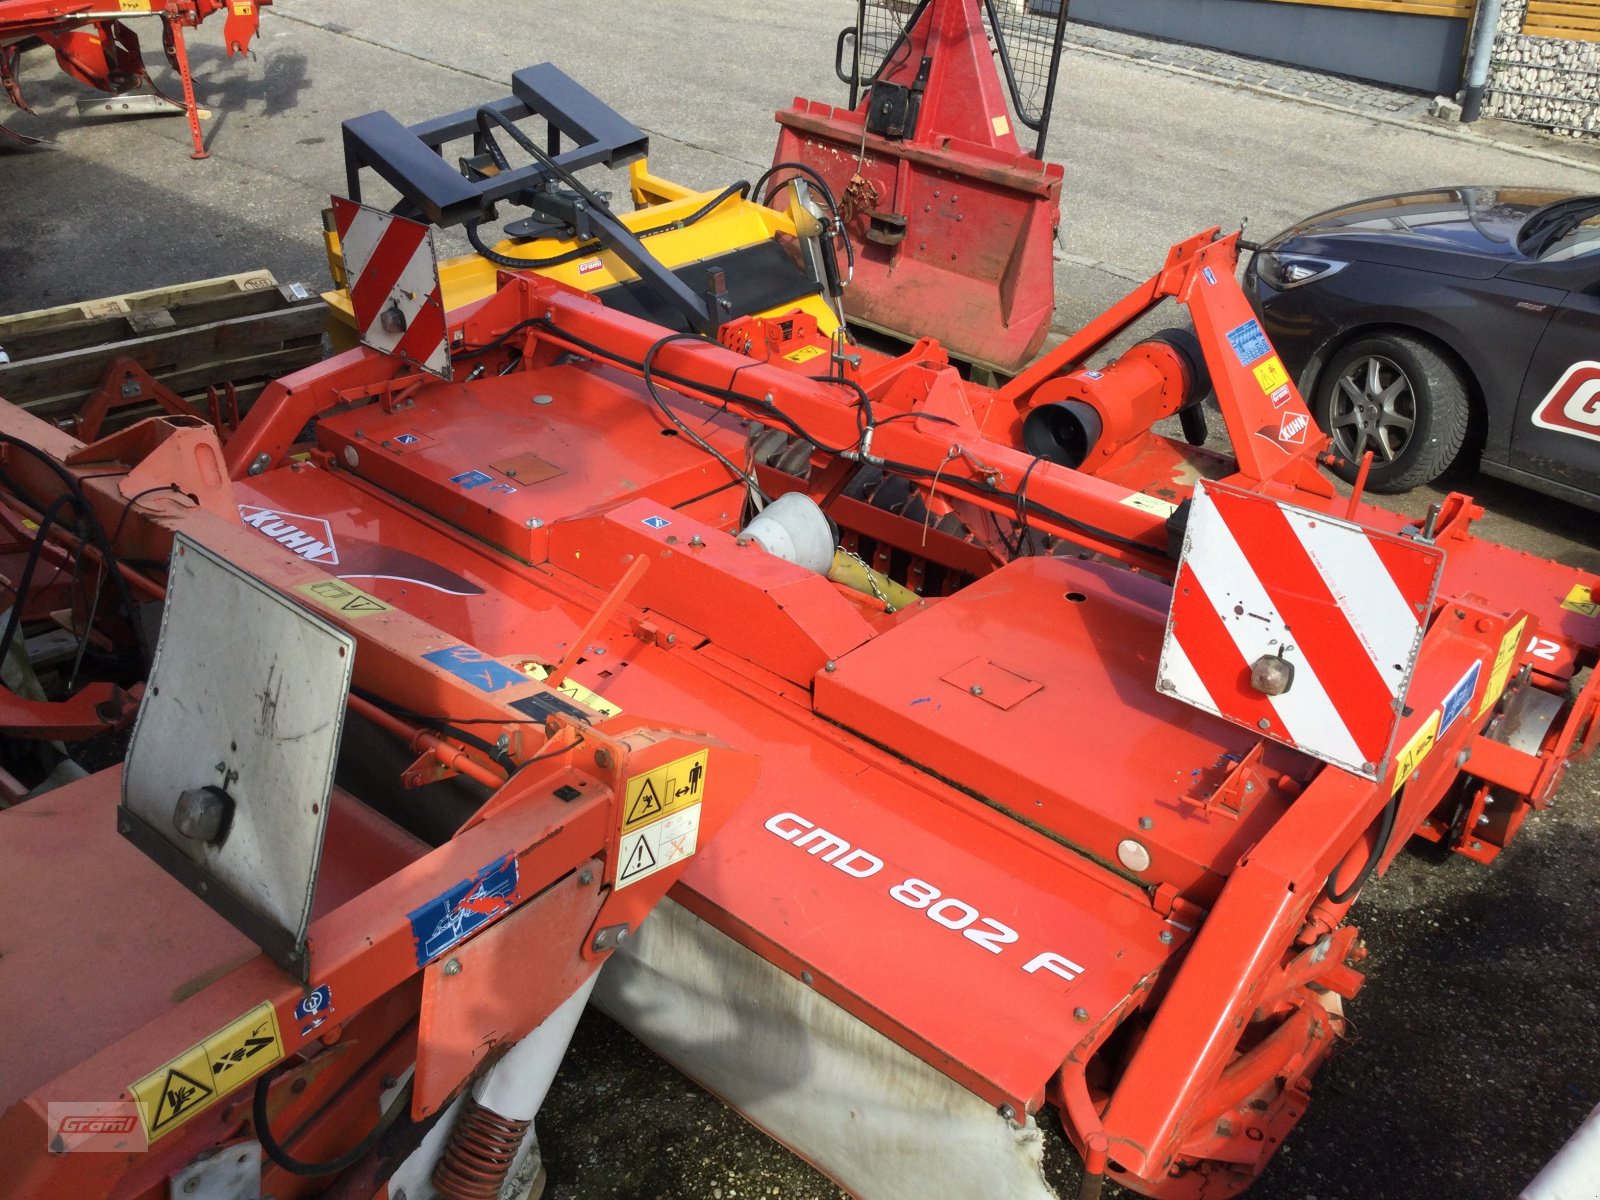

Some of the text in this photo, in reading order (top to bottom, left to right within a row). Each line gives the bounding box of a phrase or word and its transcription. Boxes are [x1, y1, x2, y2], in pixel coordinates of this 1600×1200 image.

[1280, 415, 1307, 440] KUHN
[243, 509, 335, 559] KUHN
[763, 812, 1086, 982] GMD 802 F
